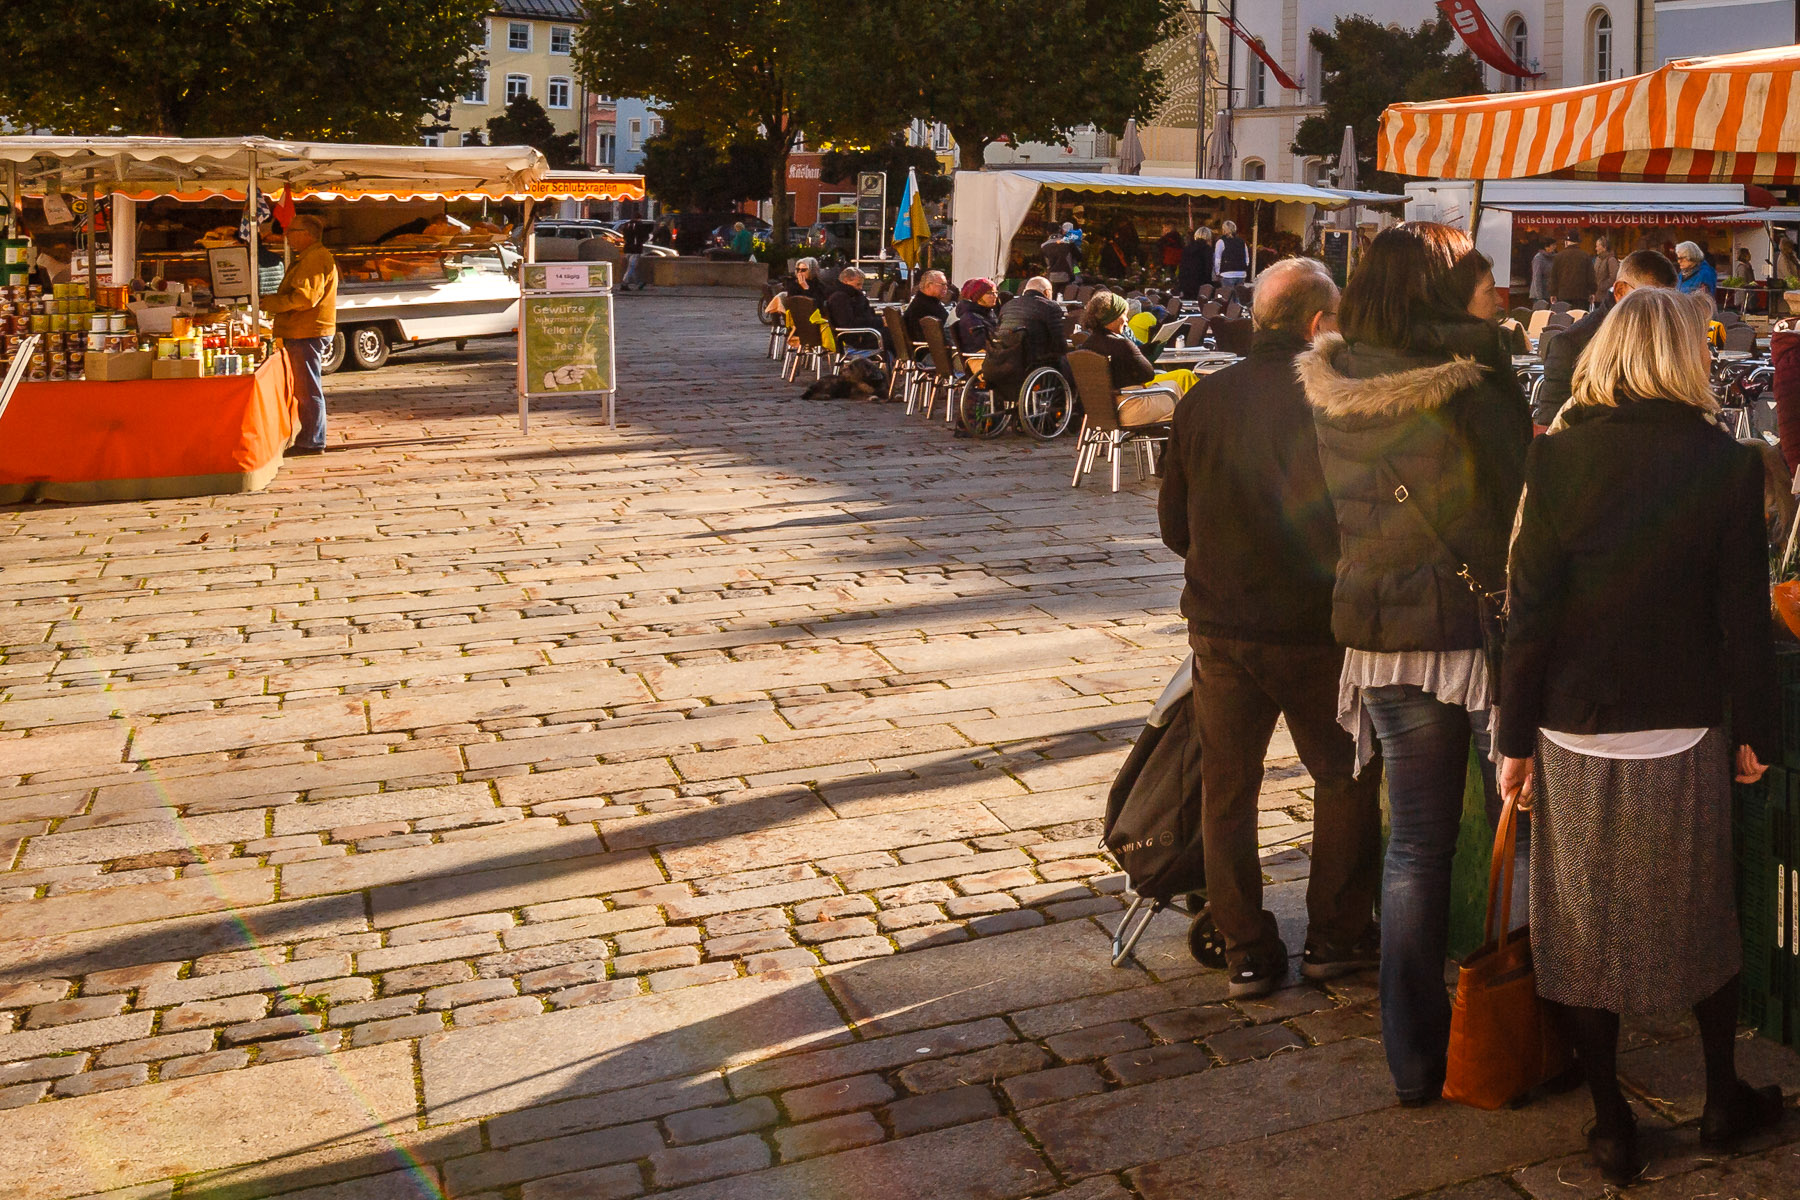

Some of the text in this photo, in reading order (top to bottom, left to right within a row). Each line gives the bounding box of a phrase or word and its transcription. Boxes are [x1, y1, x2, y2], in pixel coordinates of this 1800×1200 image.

[1513, 214, 1580, 226] leischwaren
[1588, 213, 1660, 225] METZGEREI
[1664, 213, 1699, 225] LANG
[532, 303, 586, 315] Gewürze
[569, 325, 583, 334] fix
